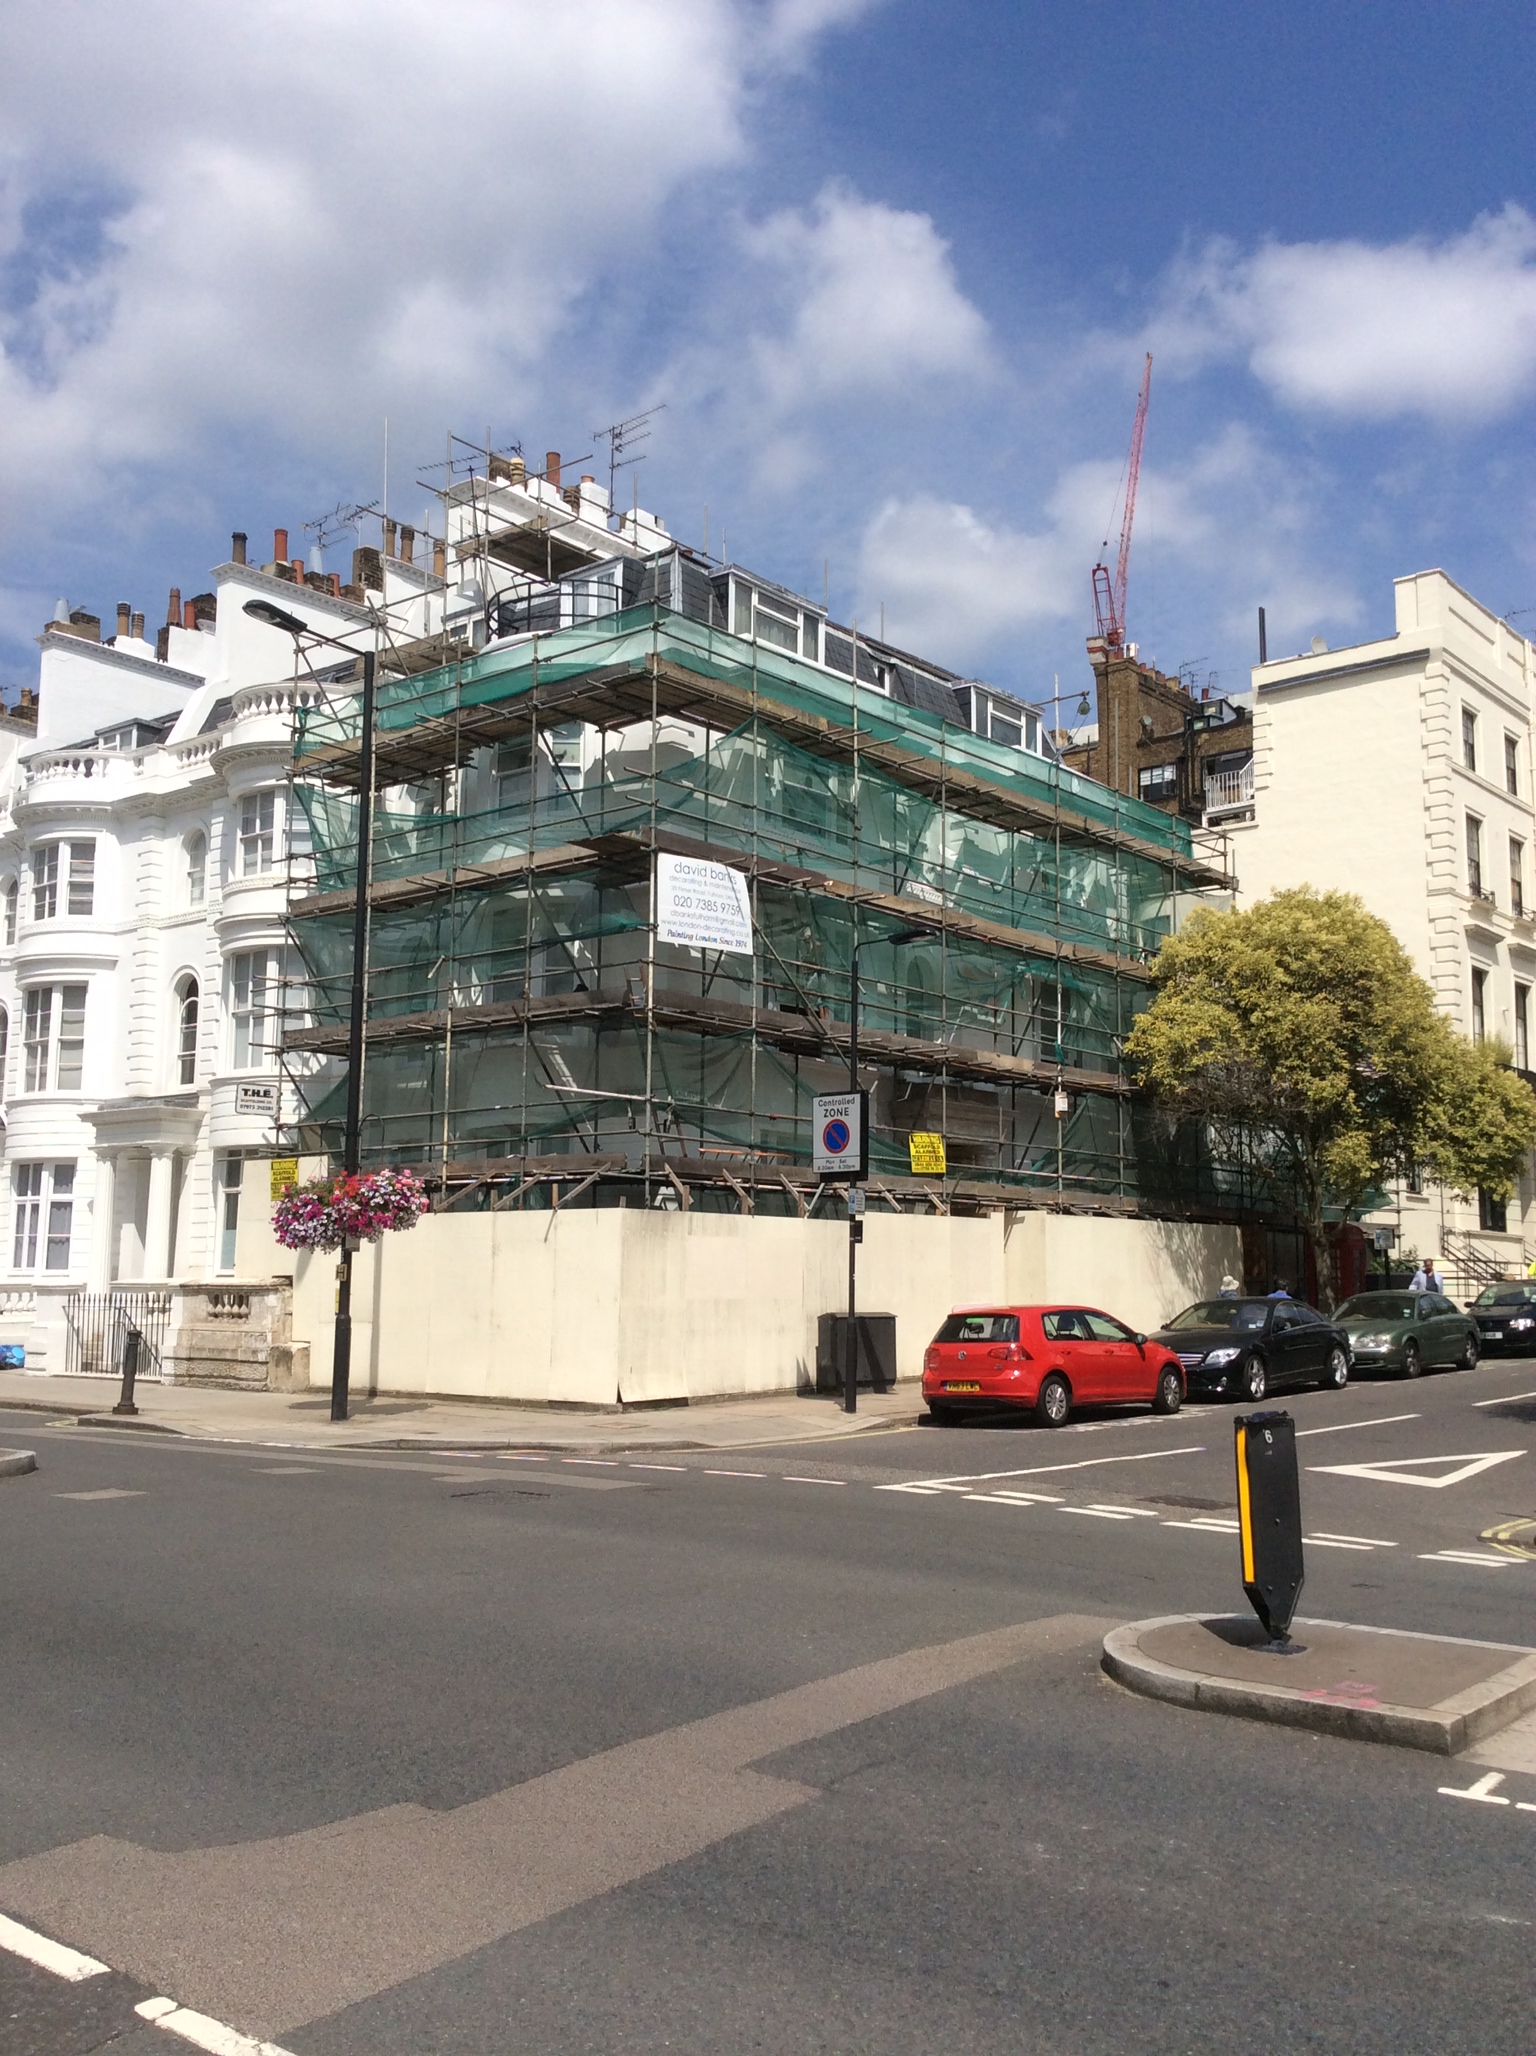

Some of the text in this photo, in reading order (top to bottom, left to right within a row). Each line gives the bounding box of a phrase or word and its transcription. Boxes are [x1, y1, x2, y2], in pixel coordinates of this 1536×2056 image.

[674, 862, 707, 877] david
[669, 875, 702, 887] decorating
[673, 895, 692, 908] 020
[696, 898, 718, 912] 7385
[720, 902, 740, 916] 9759
[667, 929, 748, 948] Painting London Since 1974
[818, 1097, 855, 1107] Controlled
[823, 1107, 850, 1118] ZONE
